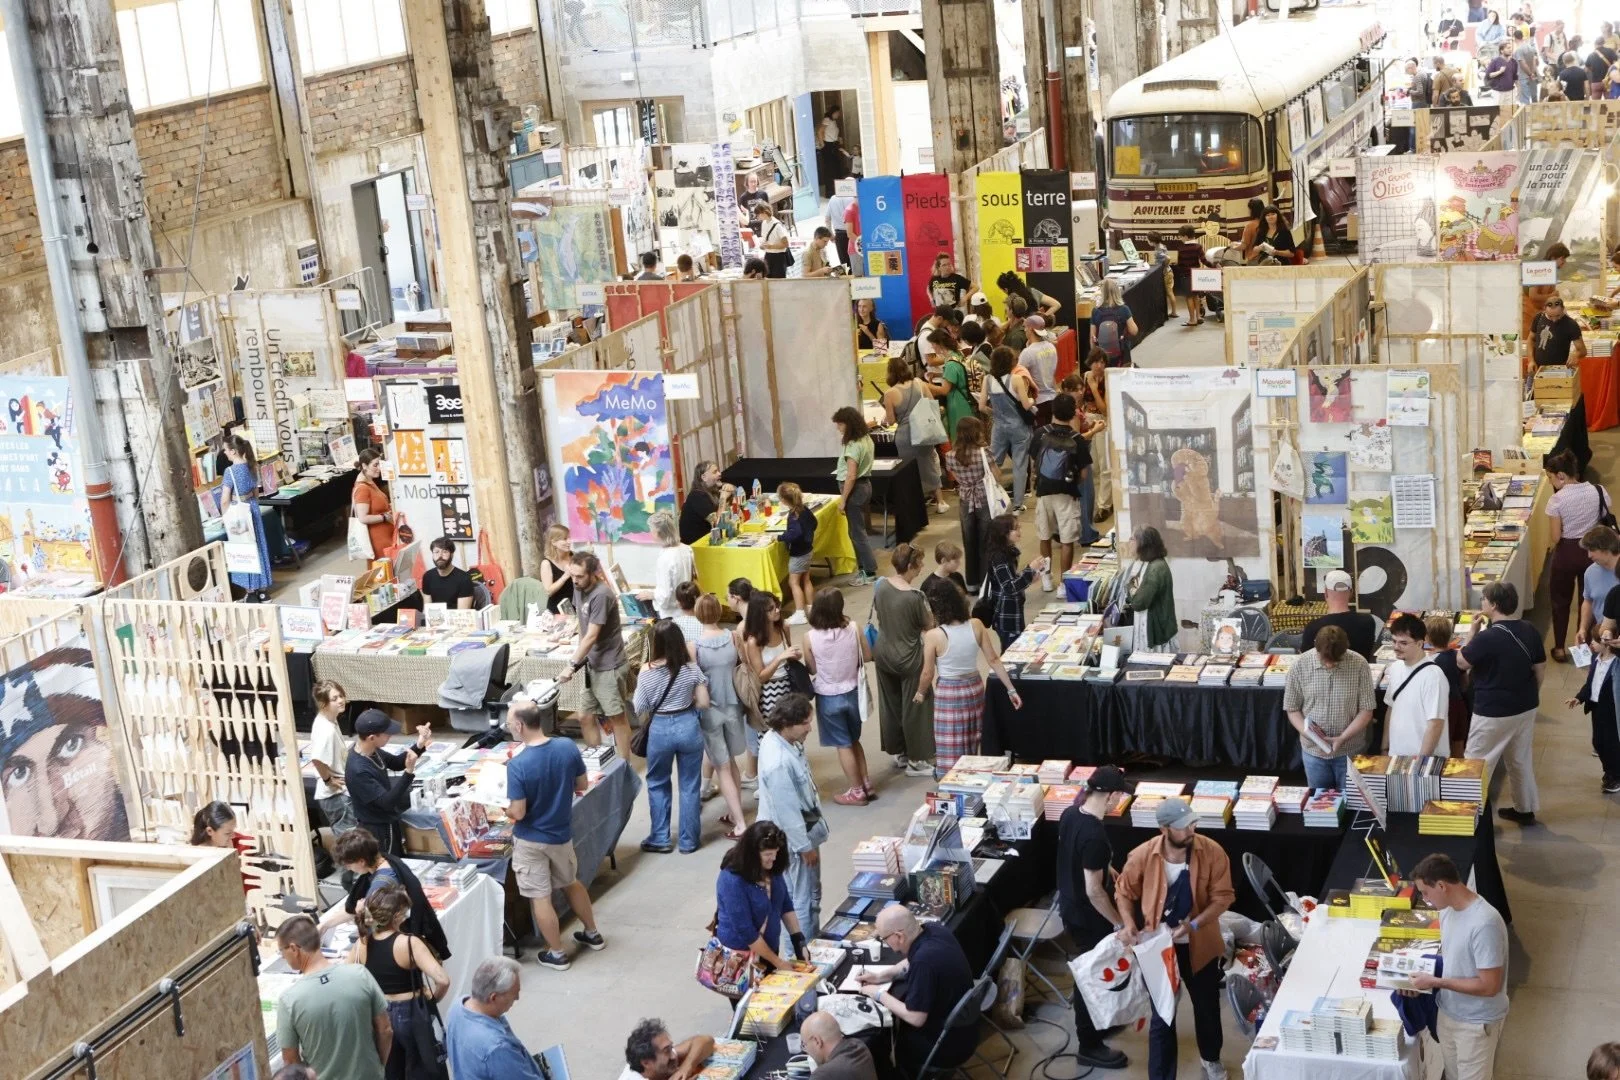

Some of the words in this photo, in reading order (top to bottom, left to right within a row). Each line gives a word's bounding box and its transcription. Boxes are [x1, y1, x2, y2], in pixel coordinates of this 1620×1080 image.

[1529, 163, 1543, 171] un
[1546, 161, 1568, 171] abri
[1541, 171, 1566, 181] pour
[1373, 181, 1415, 199] Olivia
[1526, 180, 1537, 189] la
[1540, 180, 1561, 189] nuit
[875, 195, 887, 211] 6
[906, 192, 948, 209] Pieds
[981, 192, 1019, 206] sous
[1026, 190, 1066, 206] terre
[1133, 205, 1186, 215] AQUITAINE
[1192, 204, 1221, 215] CARS
[267, 328, 281, 360] Un
[271, 361, 289, 415] crédit
[605, 394, 657, 410] MeMo
[278, 418, 295, 463] vous
